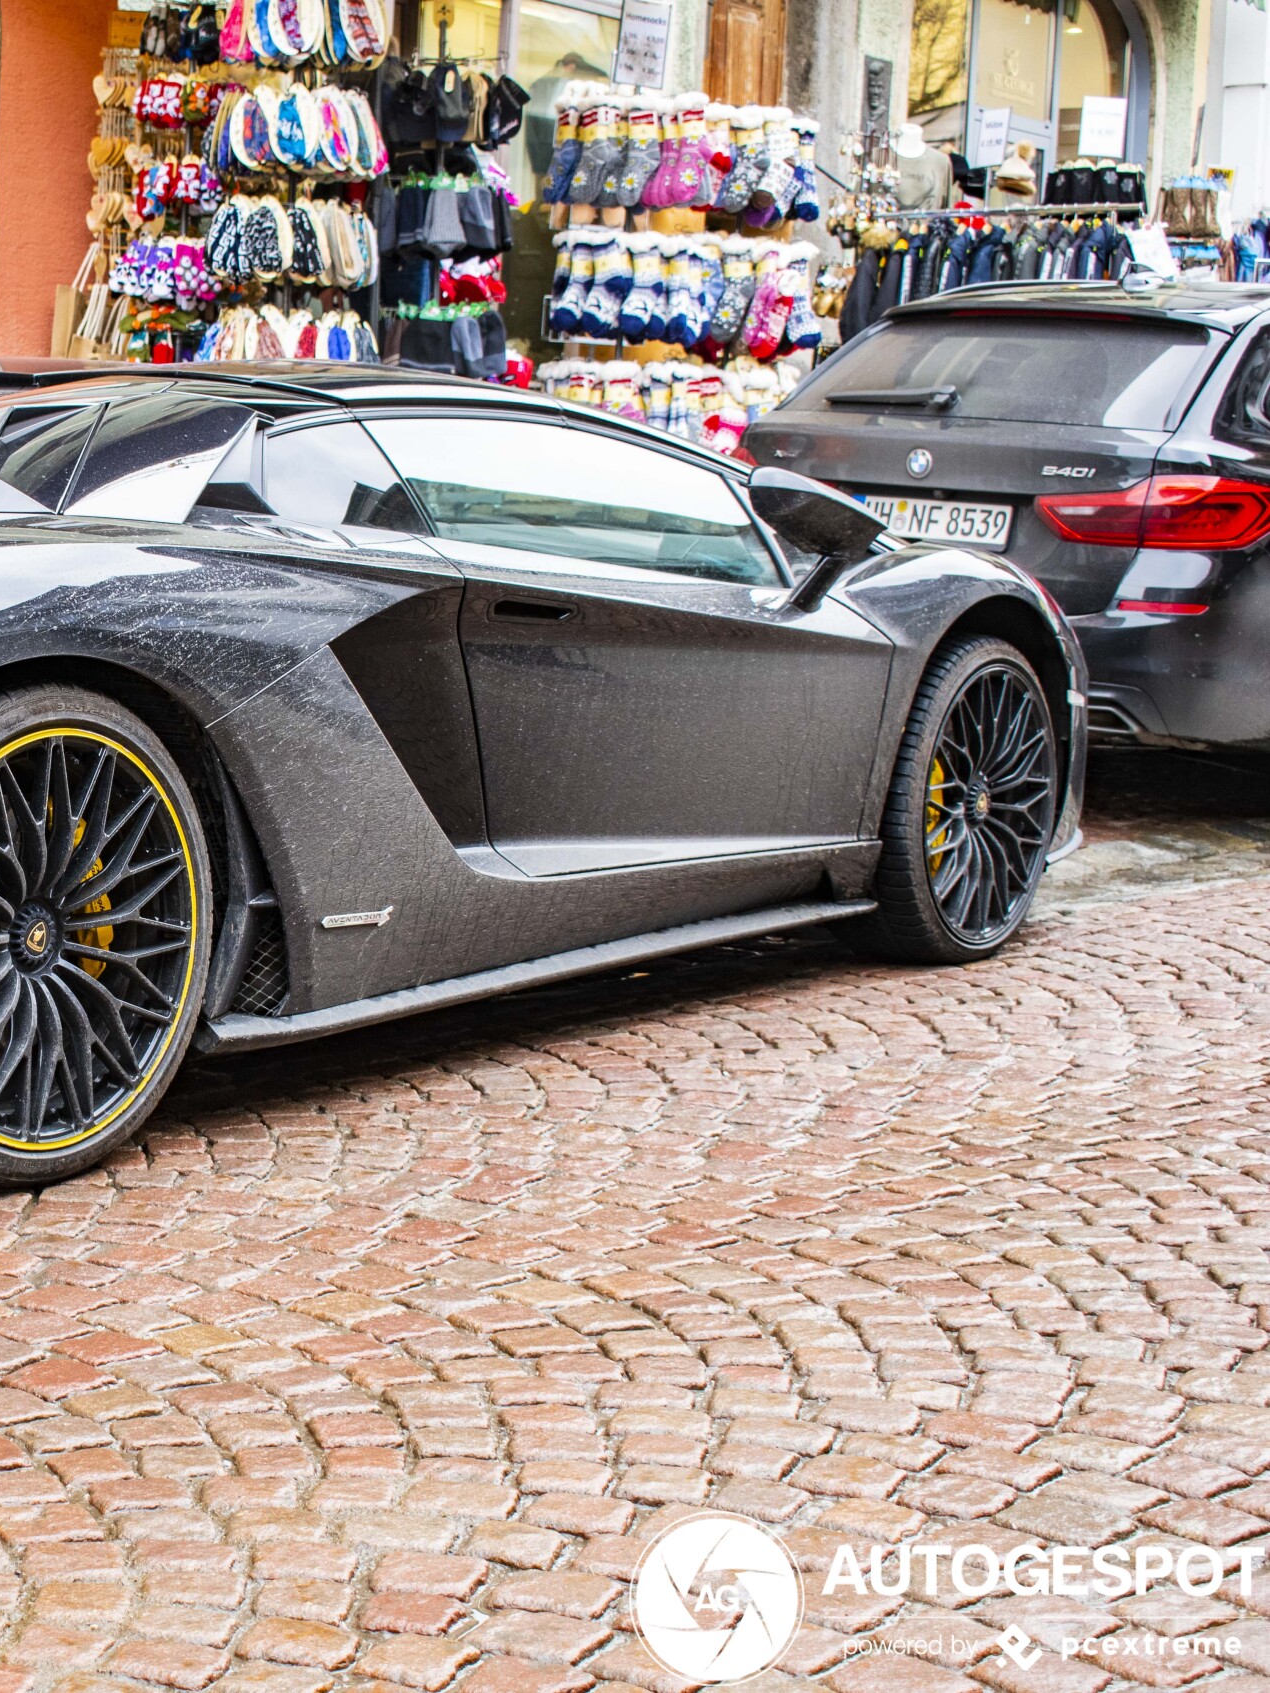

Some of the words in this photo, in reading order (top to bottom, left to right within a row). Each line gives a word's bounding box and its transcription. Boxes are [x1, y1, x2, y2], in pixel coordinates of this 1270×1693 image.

[625, 12, 667, 26] Homesocks
[908, 504, 942, 534] NF
[946, 507, 1008, 539] 8539
[327, 913, 382, 925] AVENTADOR
